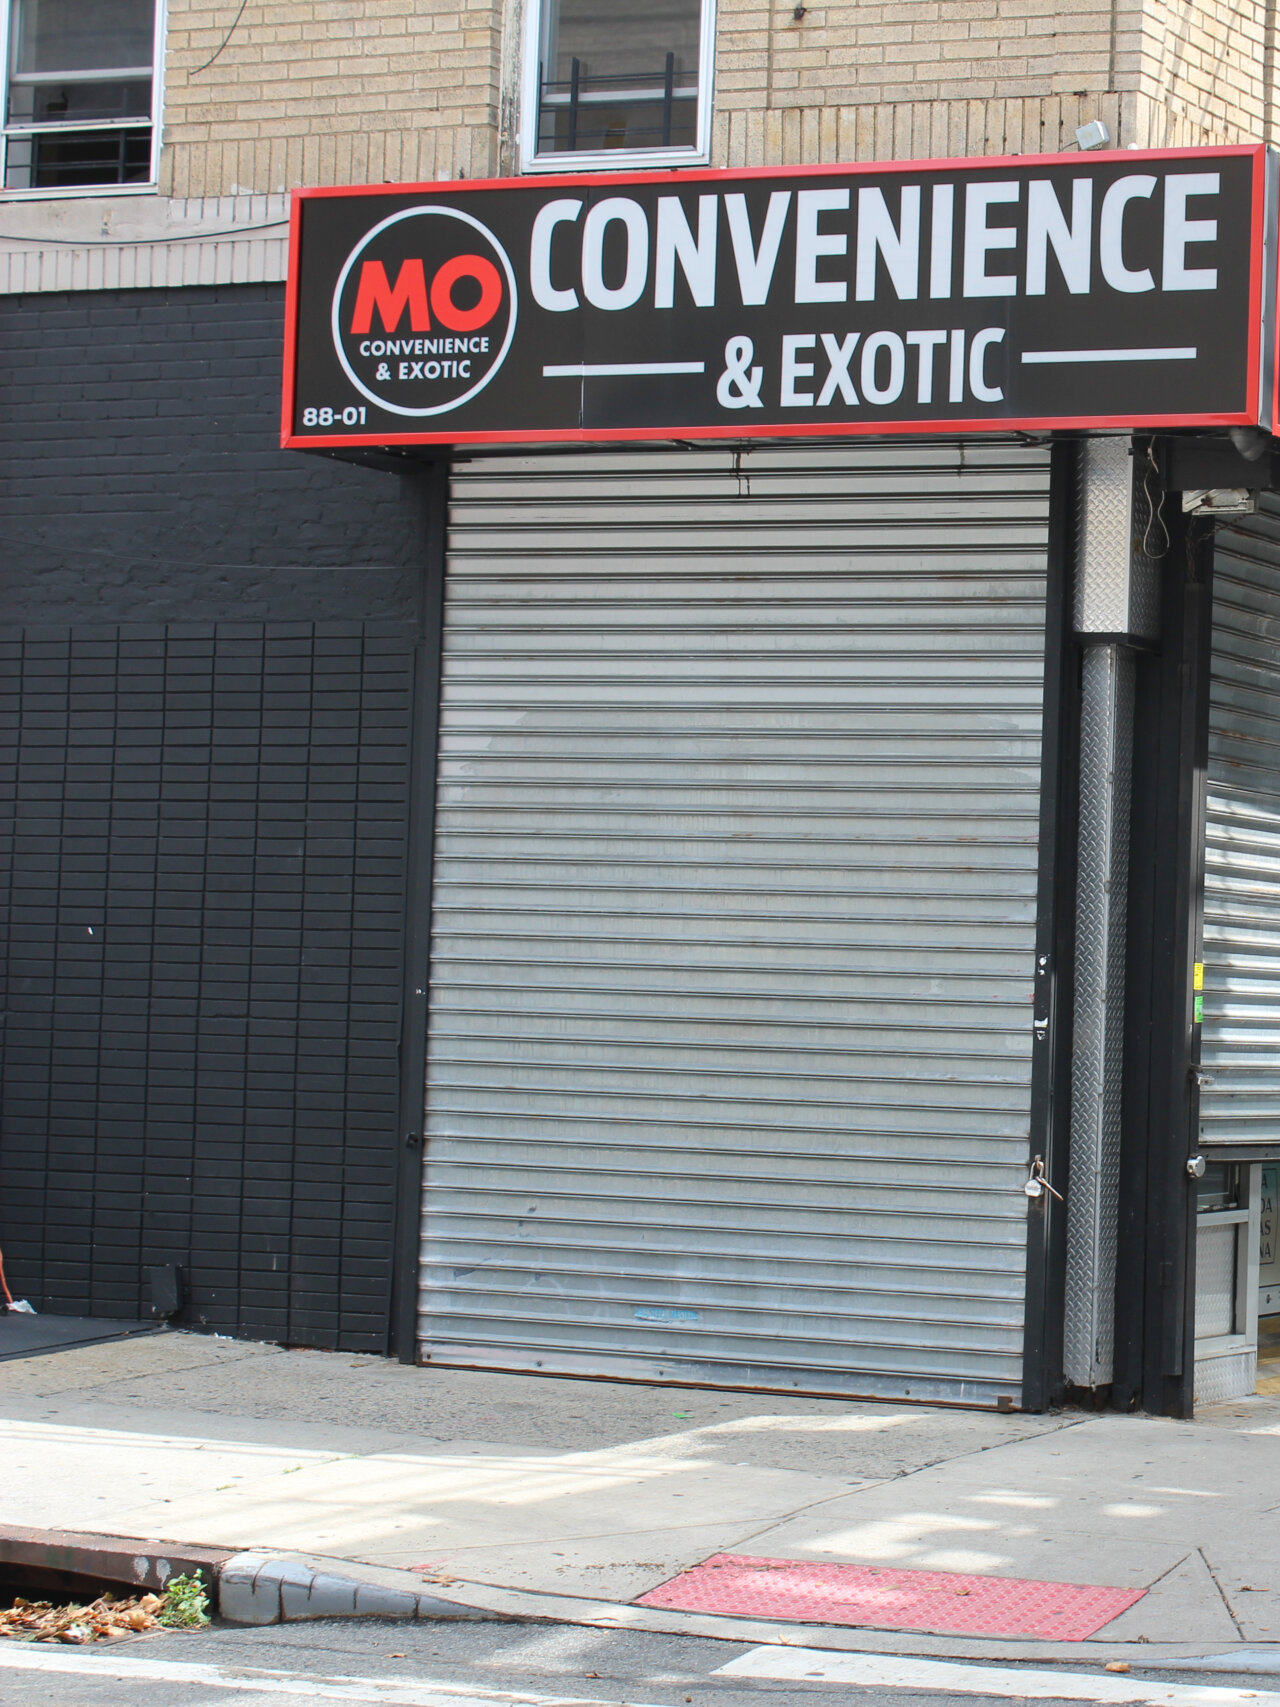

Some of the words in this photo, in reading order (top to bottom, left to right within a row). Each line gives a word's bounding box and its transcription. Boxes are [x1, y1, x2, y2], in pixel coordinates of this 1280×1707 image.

[529, 172, 1221, 312] CONVENIENCE
[351, 254, 503, 334] MO
[359, 337, 490, 357] CONVENIENCE
[375, 362, 391, 381] &
[399, 360, 471, 379] EXOTIC
[717, 335, 764, 409] &
[779, 327, 1006, 407] EXOTIC
[302, 406, 366, 427] 88-01
